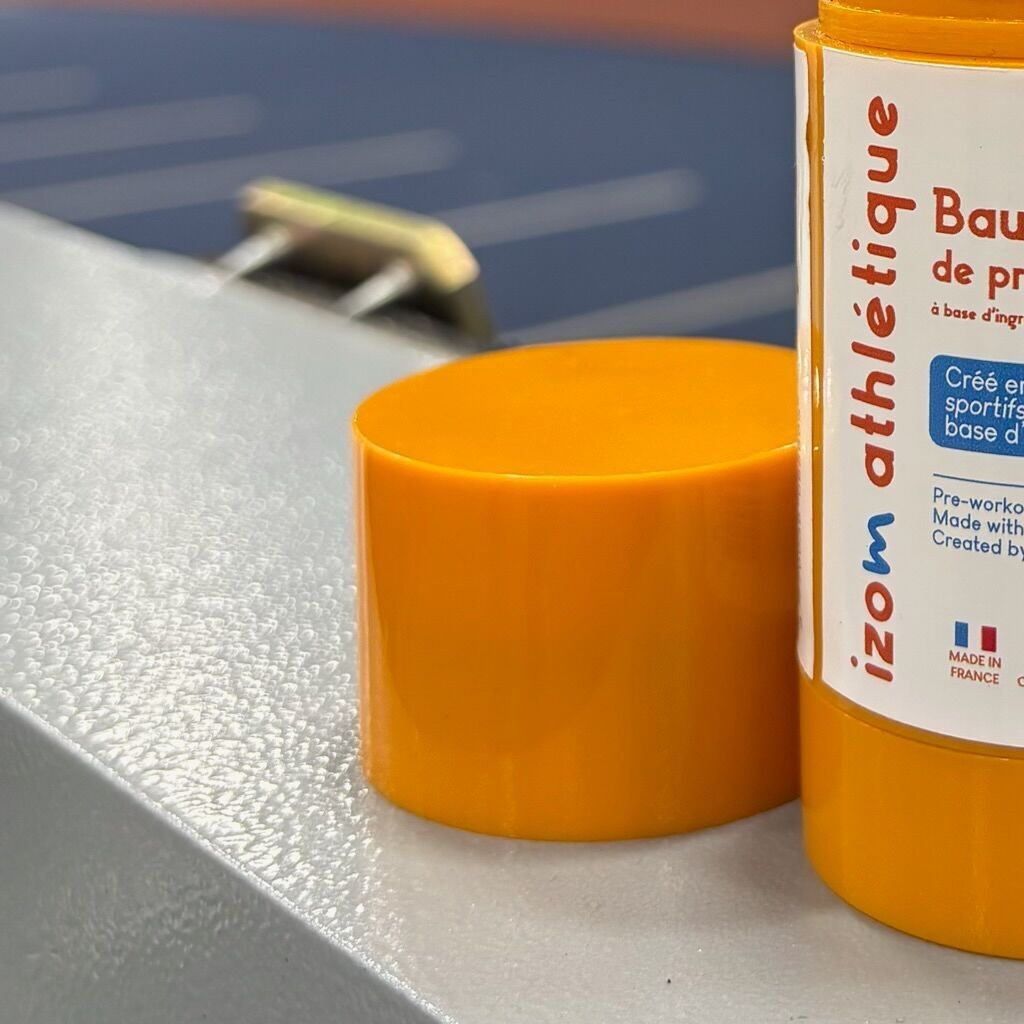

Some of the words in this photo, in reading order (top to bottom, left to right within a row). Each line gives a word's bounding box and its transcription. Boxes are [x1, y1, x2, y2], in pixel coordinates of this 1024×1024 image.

[931, 249, 974, 285] de
[850, 94, 917, 489] athlétique
[931, 302, 940, 316] à
[944, 303, 976, 321] base
[945, 366, 998, 390] Créé
[945, 415, 998, 442] base
[932, 508, 981, 530] Made
[988, 517, 1024, 537] with
[932, 529, 1002, 555] Created
[949, 651, 985, 666] MADE
[988, 657, 1001, 668] IN
[950, 667, 1000, 685] FRANCE
